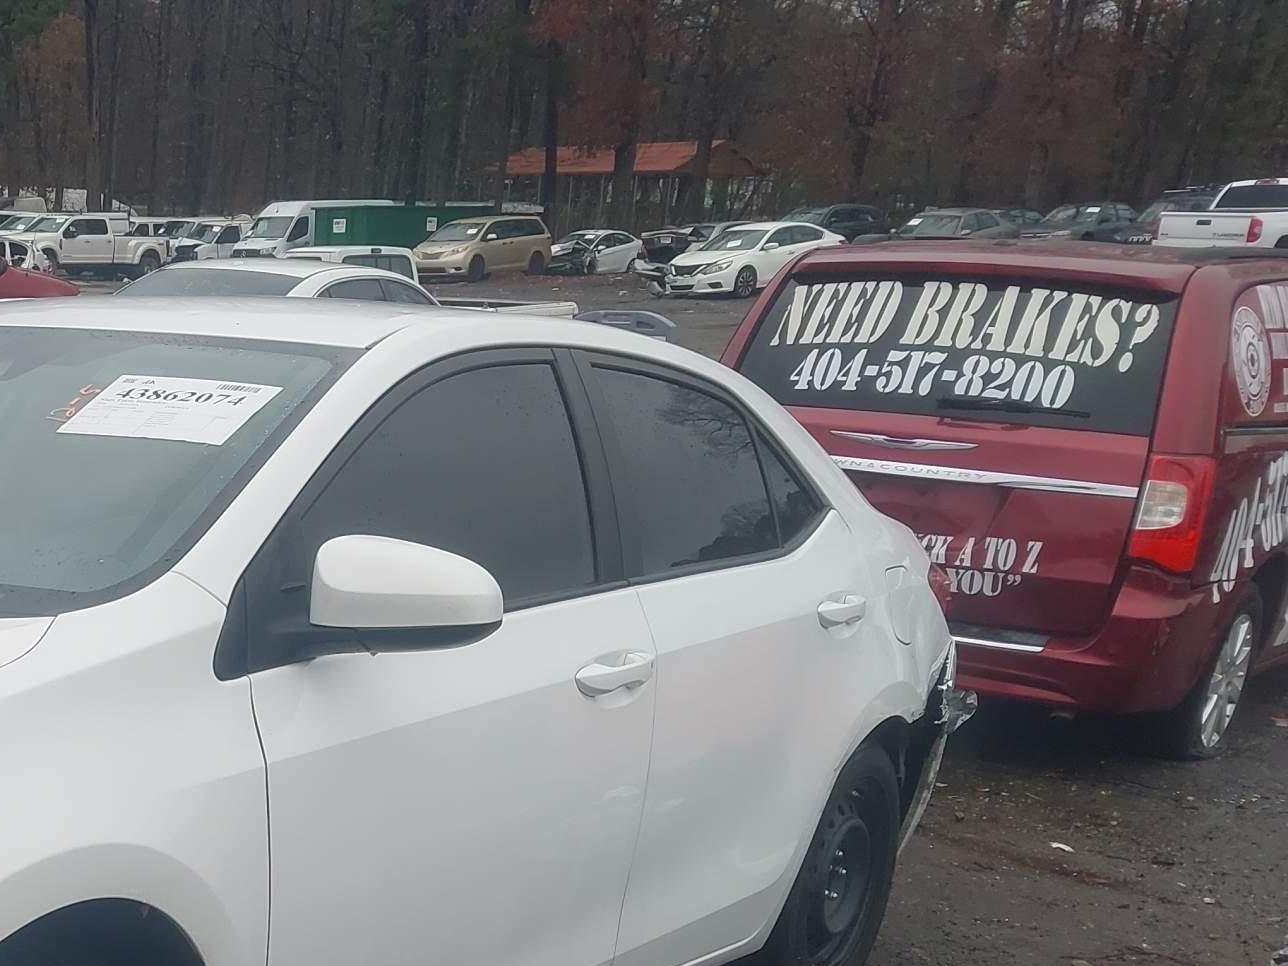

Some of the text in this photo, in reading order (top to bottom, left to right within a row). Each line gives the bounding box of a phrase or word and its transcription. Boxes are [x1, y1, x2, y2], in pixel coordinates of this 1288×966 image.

[769, 281, 904, 346] NEED
[899, 281, 1160, 373] BRAKES?
[116, 387, 247, 406] 43862074
[790, 348, 1075, 409] 404-517-8200
[954, 537, 976, 566] A
[982, 536, 1017, 571] TO
[1021, 541, 1044, 574] Z
